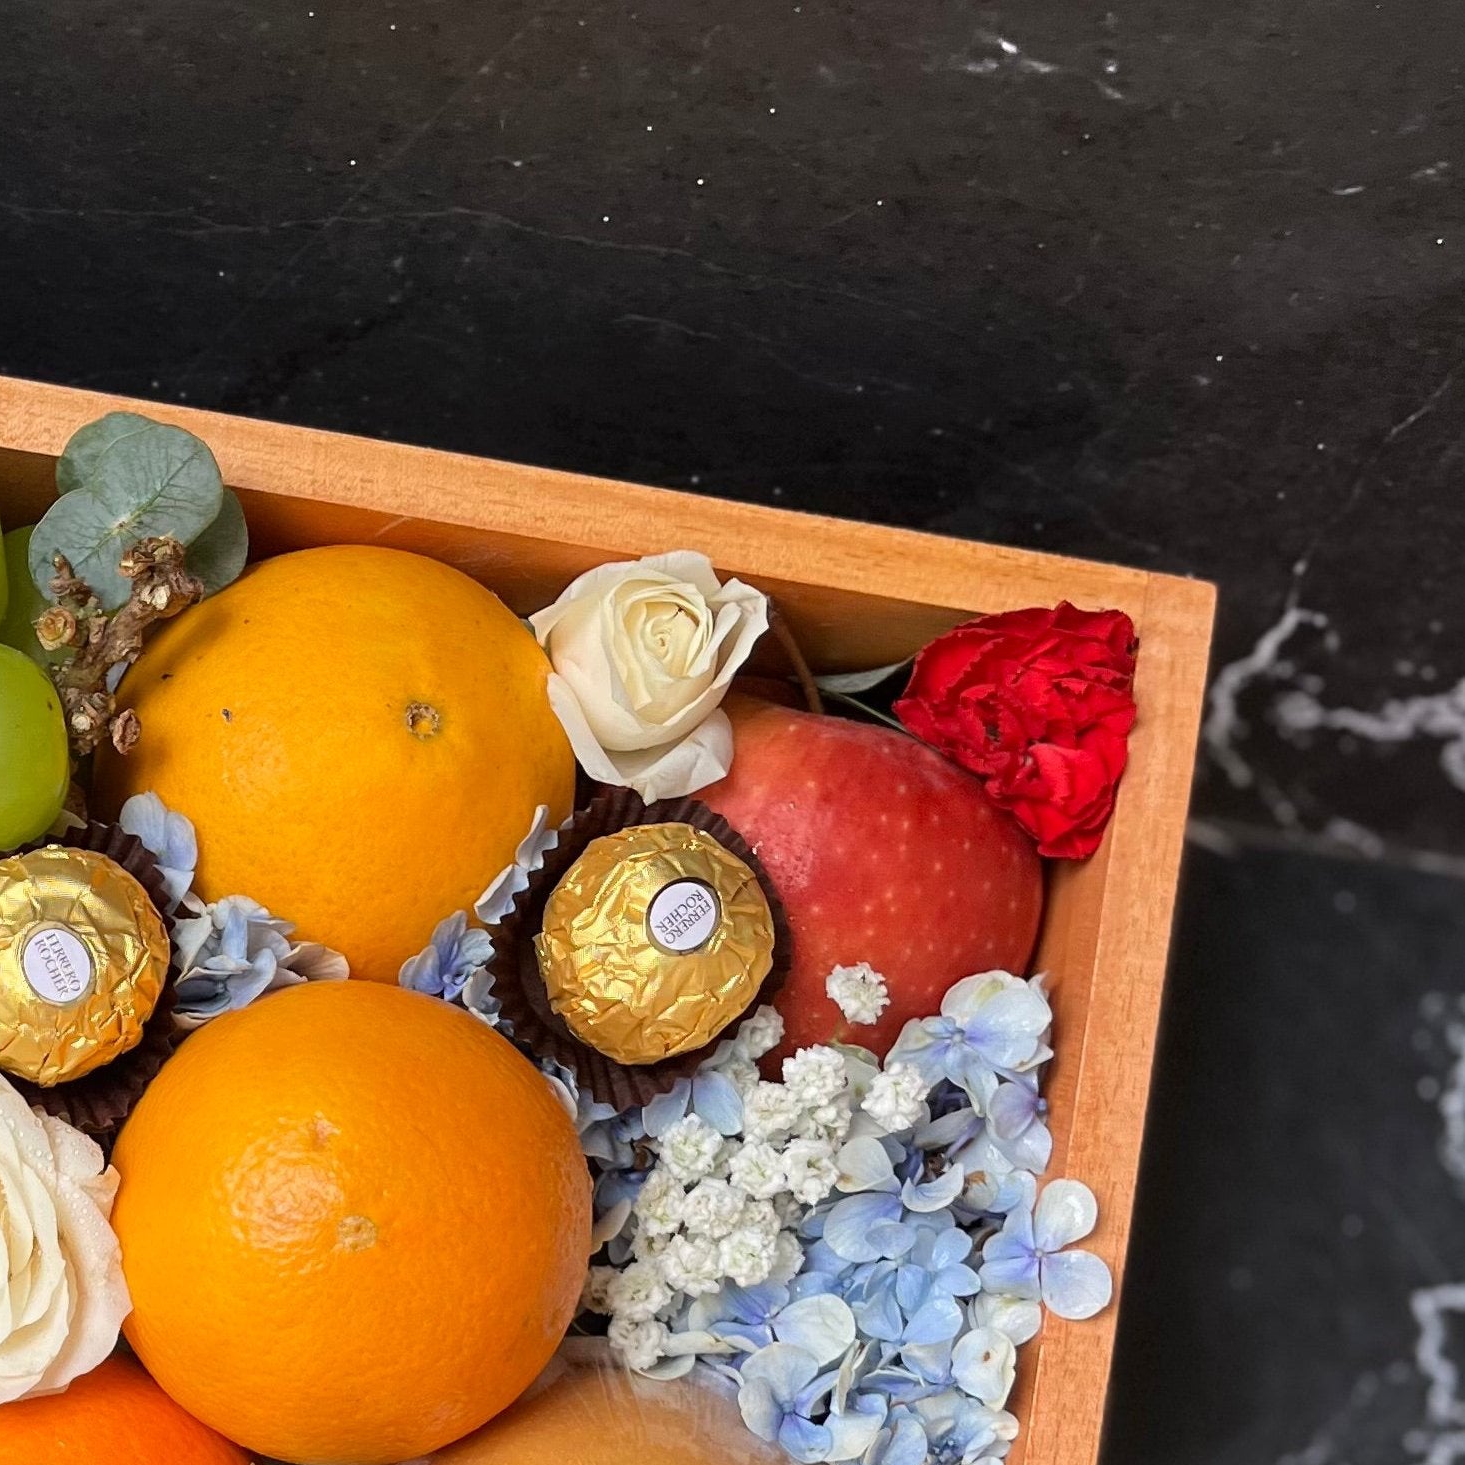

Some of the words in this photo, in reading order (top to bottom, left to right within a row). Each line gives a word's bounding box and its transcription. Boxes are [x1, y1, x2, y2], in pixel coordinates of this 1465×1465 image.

[654, 889, 705, 933] ROCHER
[664, 900, 712, 944] FERRERO
[34, 938, 70, 998] ROCHER
[46, 933, 81, 992] FERRERO
